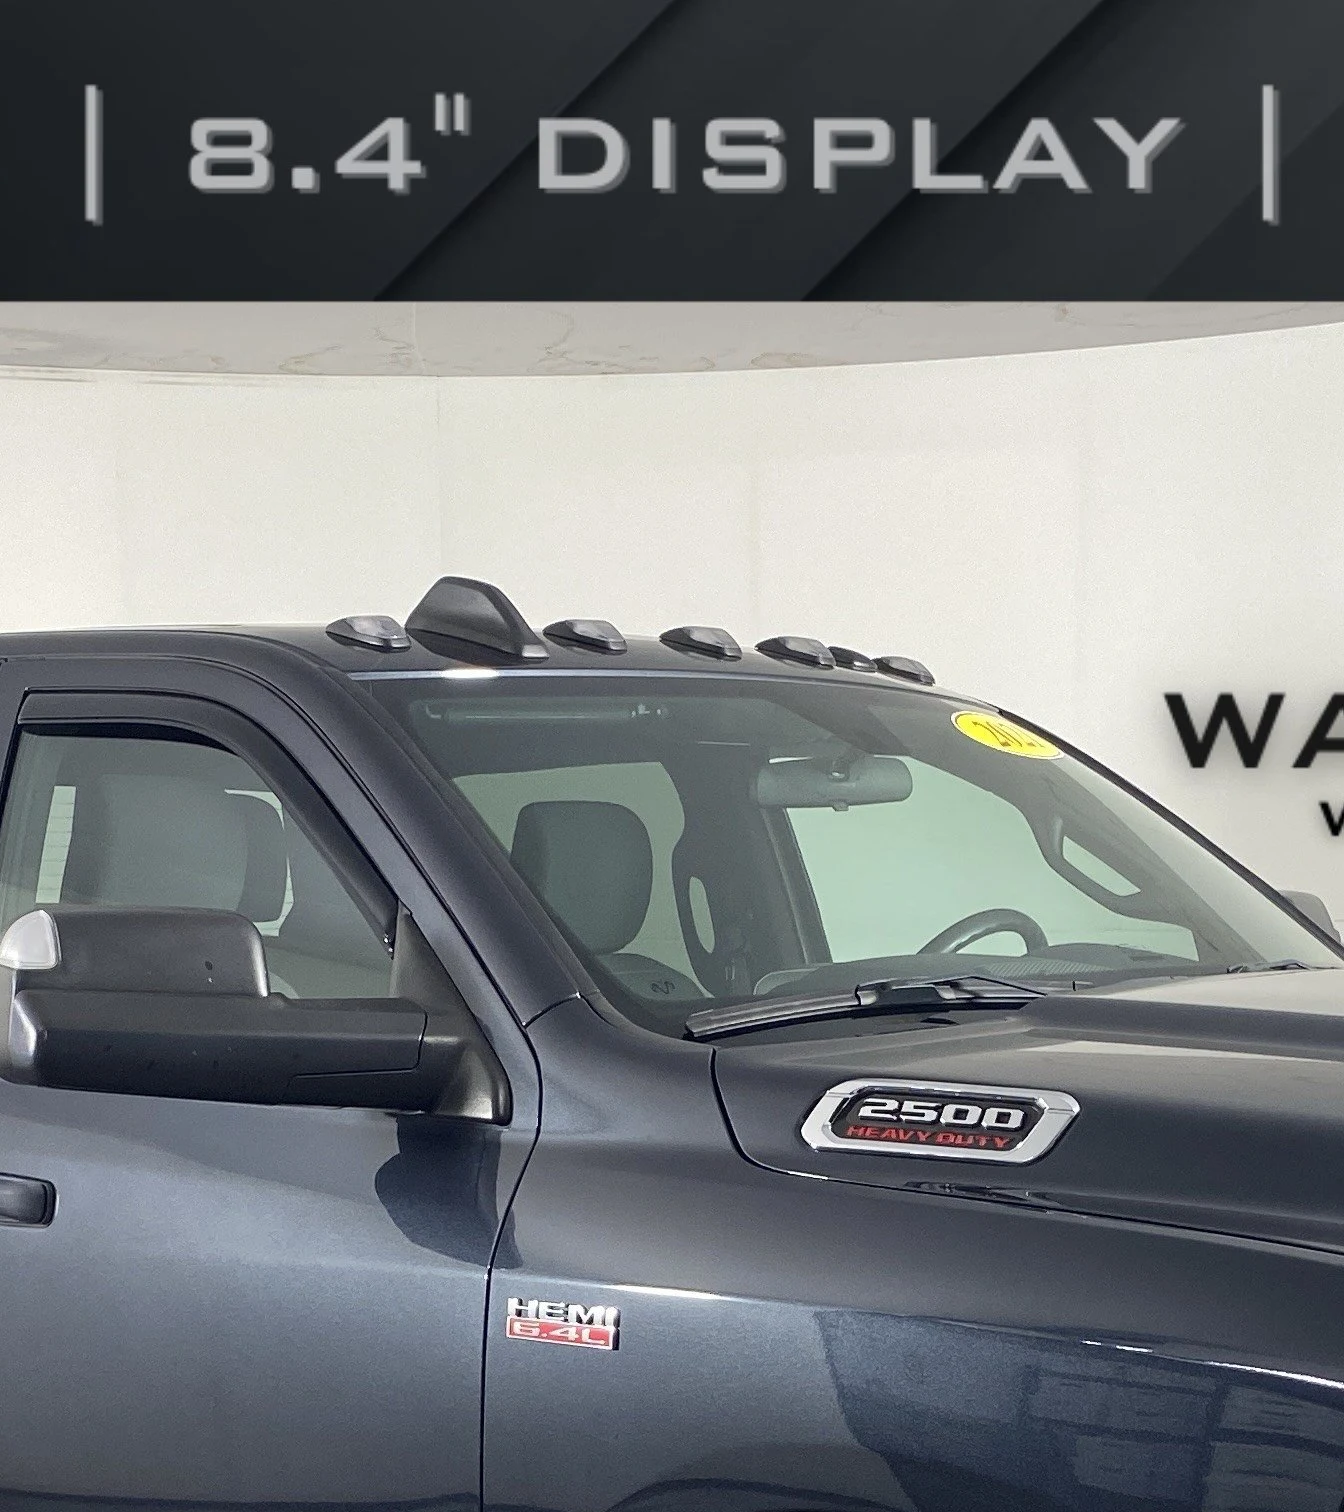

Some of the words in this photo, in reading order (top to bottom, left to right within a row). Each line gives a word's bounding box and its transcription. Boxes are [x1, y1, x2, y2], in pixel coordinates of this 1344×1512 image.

[858, 1097, 1026, 1130] 2500
[846, 1125, 934, 1145] HEAVY
[935, 1132, 1014, 1149] DUTY
[507, 1297, 619, 1327] HEMI
[513, 1321, 606, 1345] 6.4L
